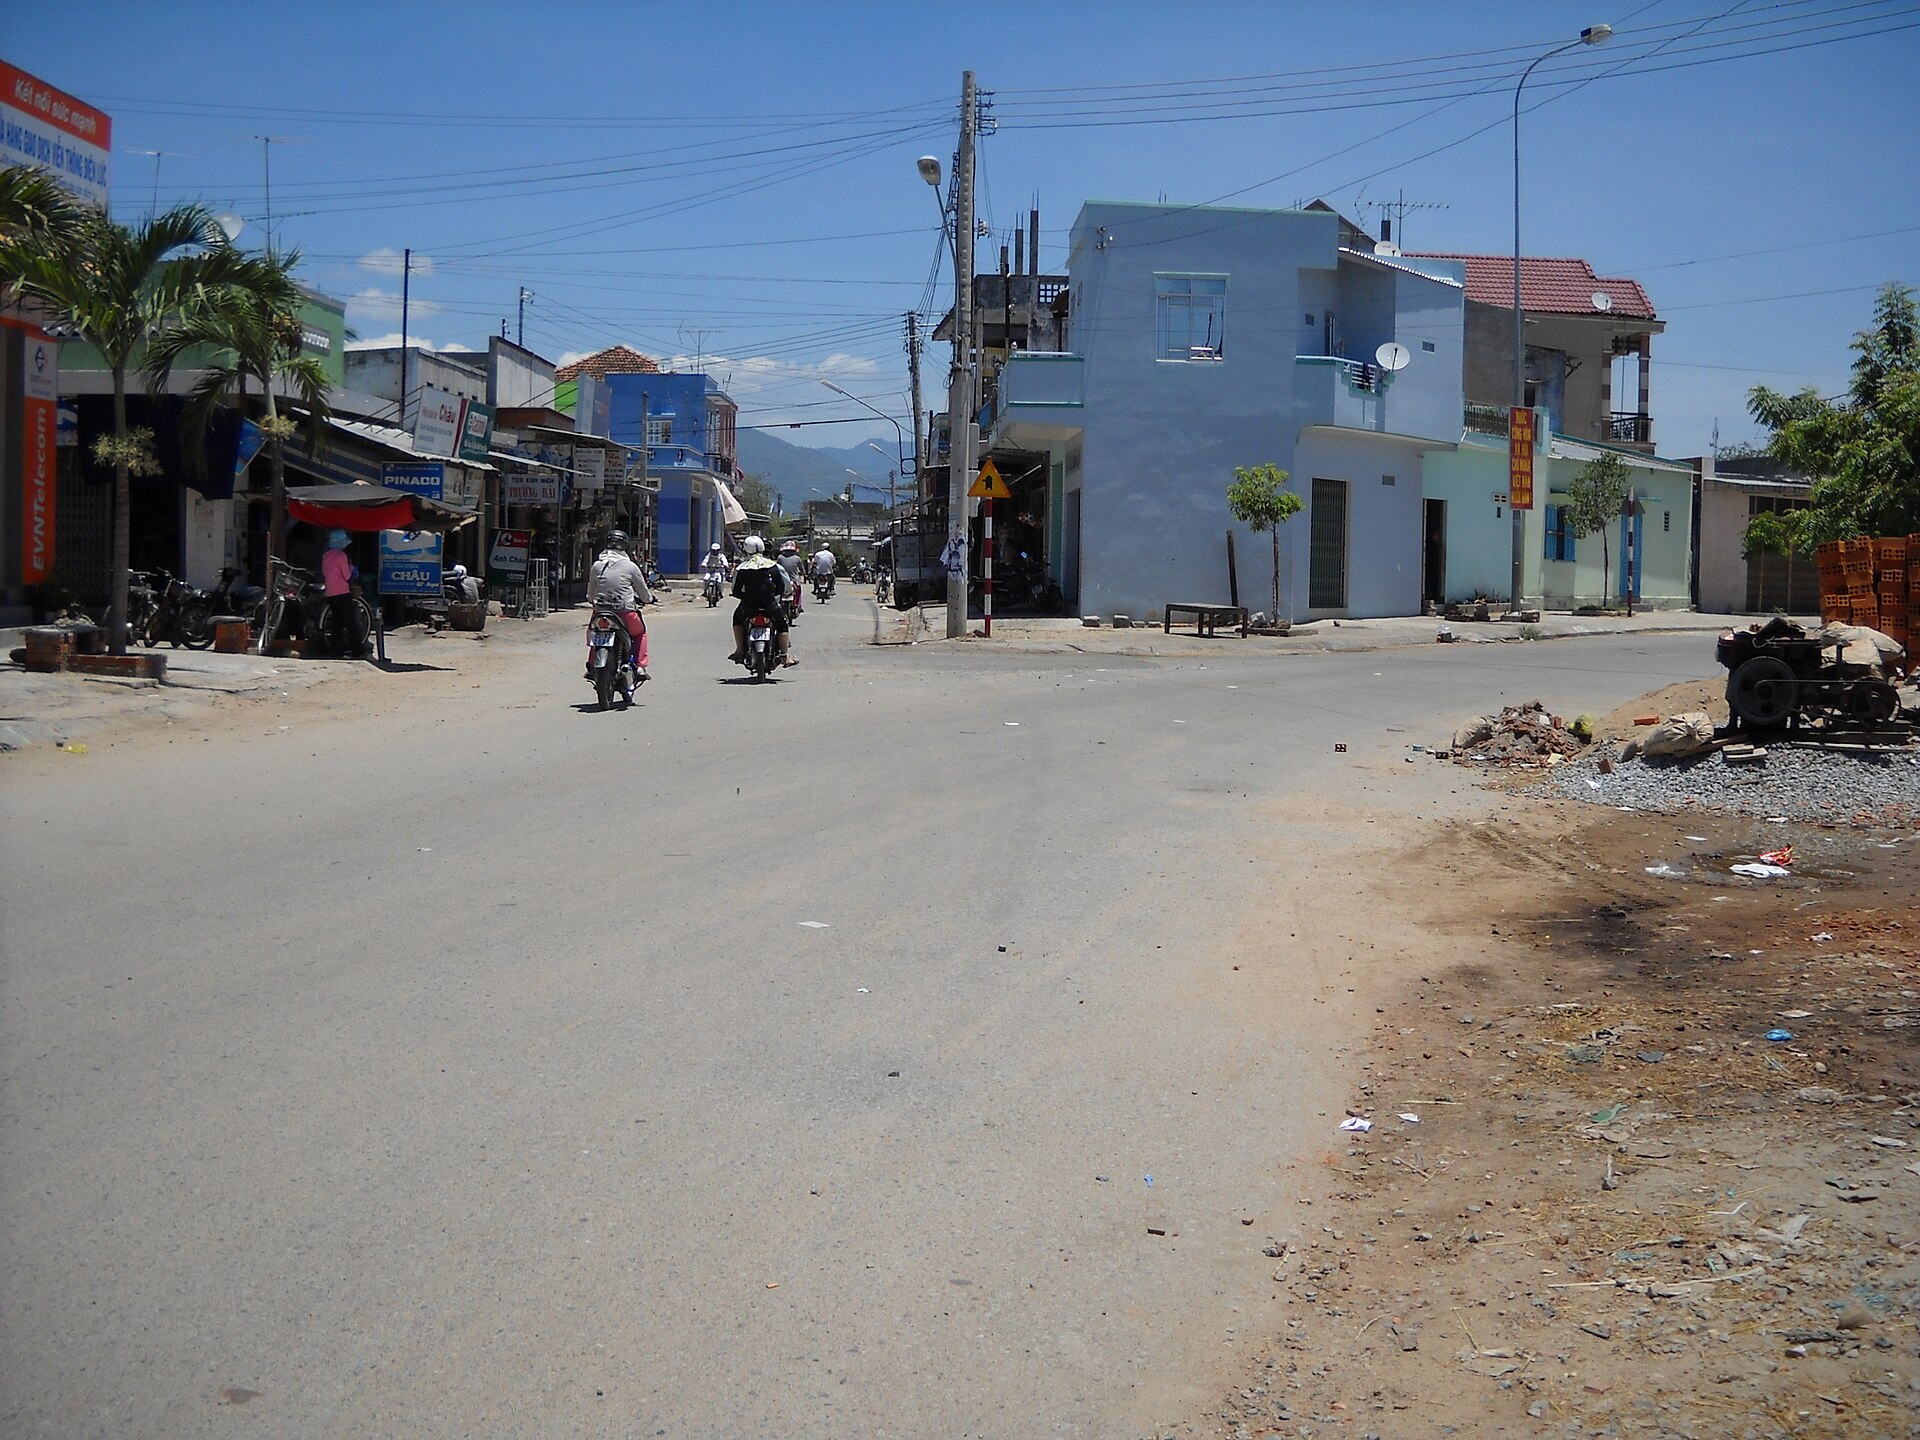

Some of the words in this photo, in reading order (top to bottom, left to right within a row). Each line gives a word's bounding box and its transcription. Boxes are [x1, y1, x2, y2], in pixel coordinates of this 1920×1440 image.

[384, 476, 440, 486] PINACO
[33, 406, 47, 571] EVNTelecom
[391, 569, 430, 581] CHÂU
